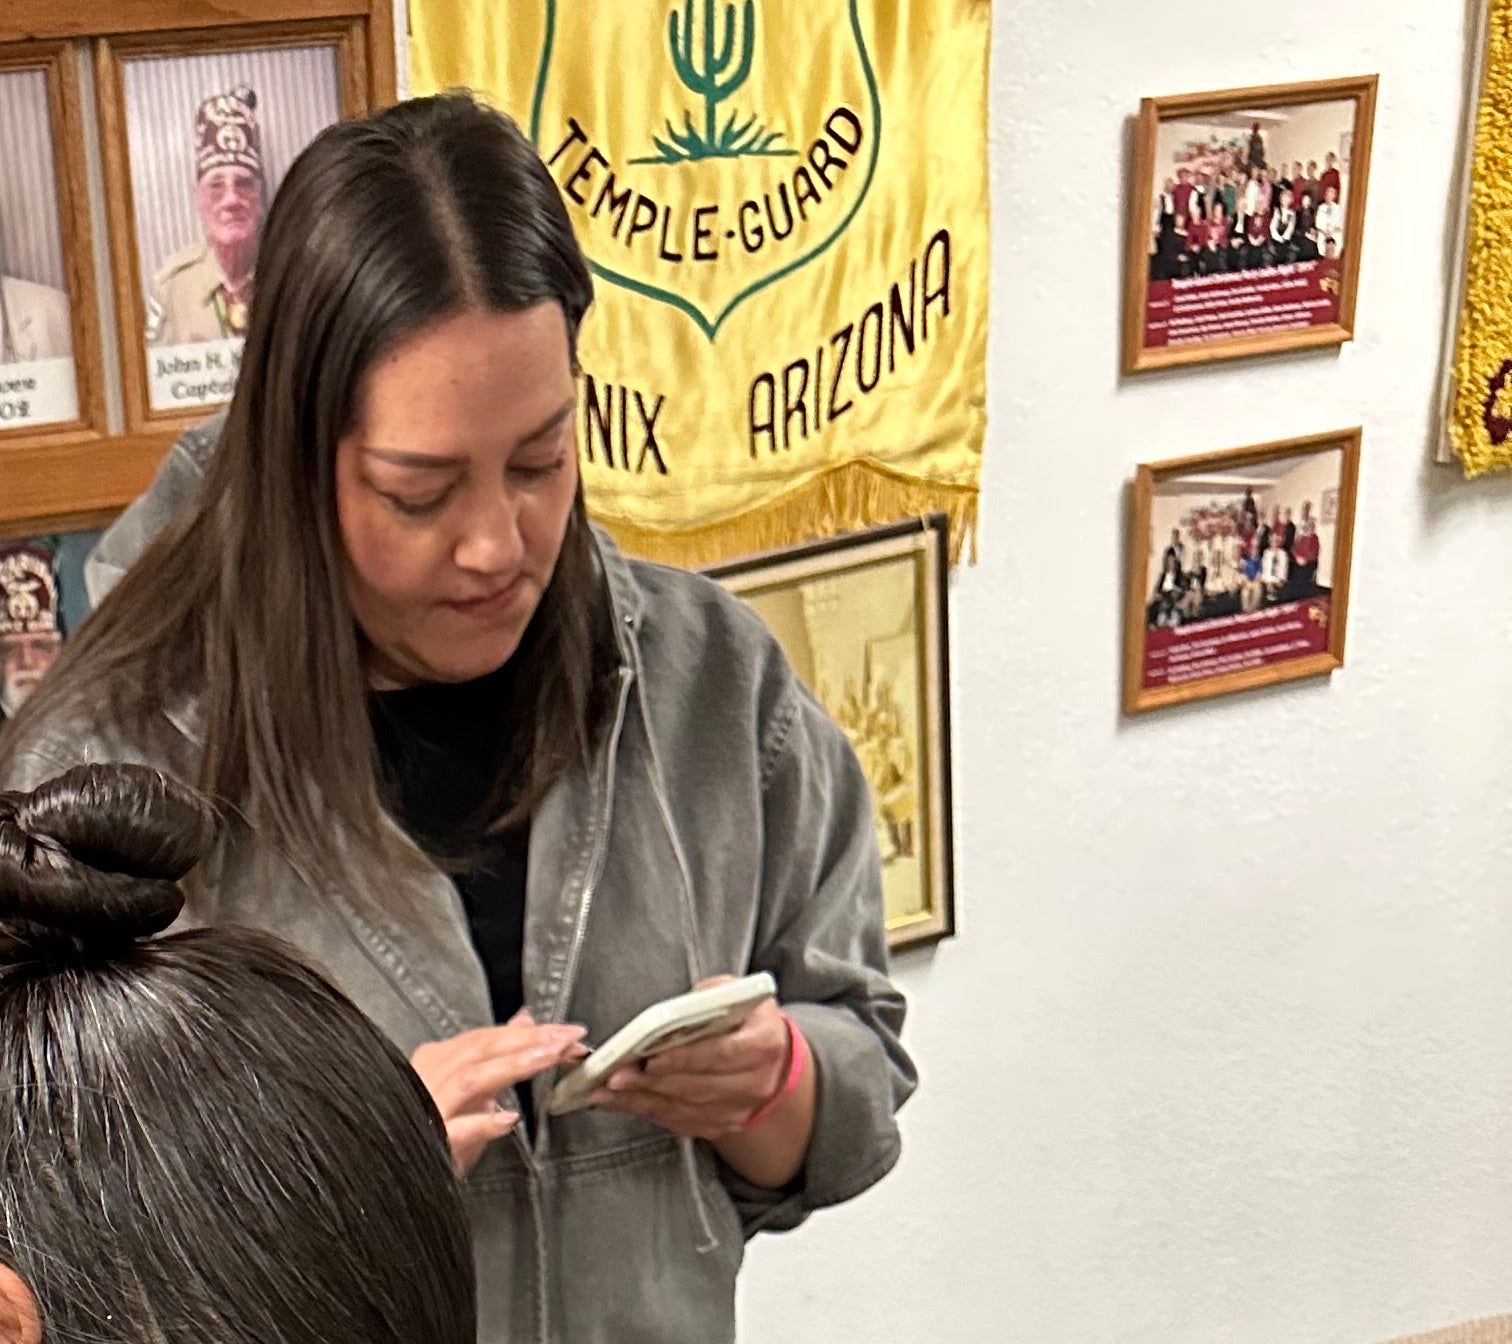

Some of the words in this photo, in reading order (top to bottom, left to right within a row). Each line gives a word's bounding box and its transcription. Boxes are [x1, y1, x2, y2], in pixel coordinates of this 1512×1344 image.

[171, 381, 234, 401] Capta
[748, 229, 953, 459] ARIZONA
[583, 373, 668, 475] NIX
